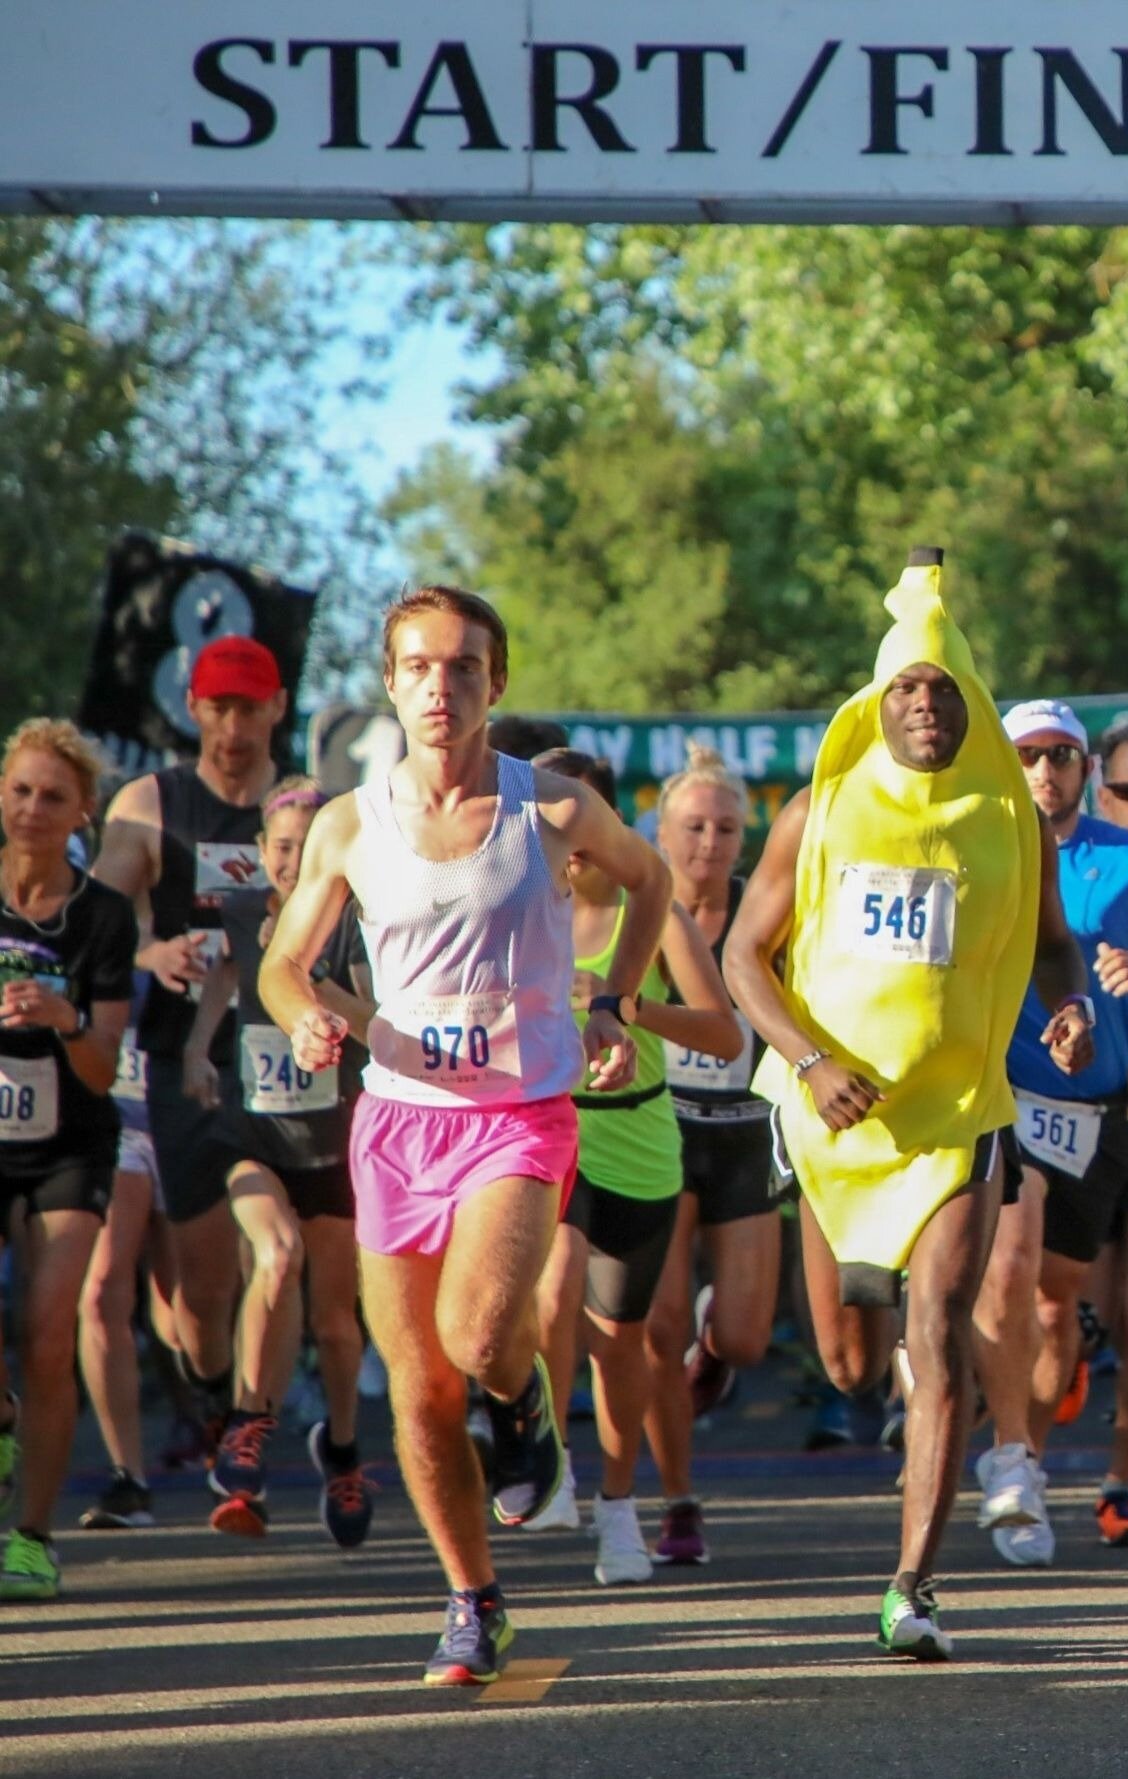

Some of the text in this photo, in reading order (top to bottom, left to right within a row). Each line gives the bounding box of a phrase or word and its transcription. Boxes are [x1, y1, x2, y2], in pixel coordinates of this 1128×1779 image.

[863, 893, 926, 940] 546
[421, 1024, 490, 1071] 970
[1031, 1108, 1077, 1154] 561
